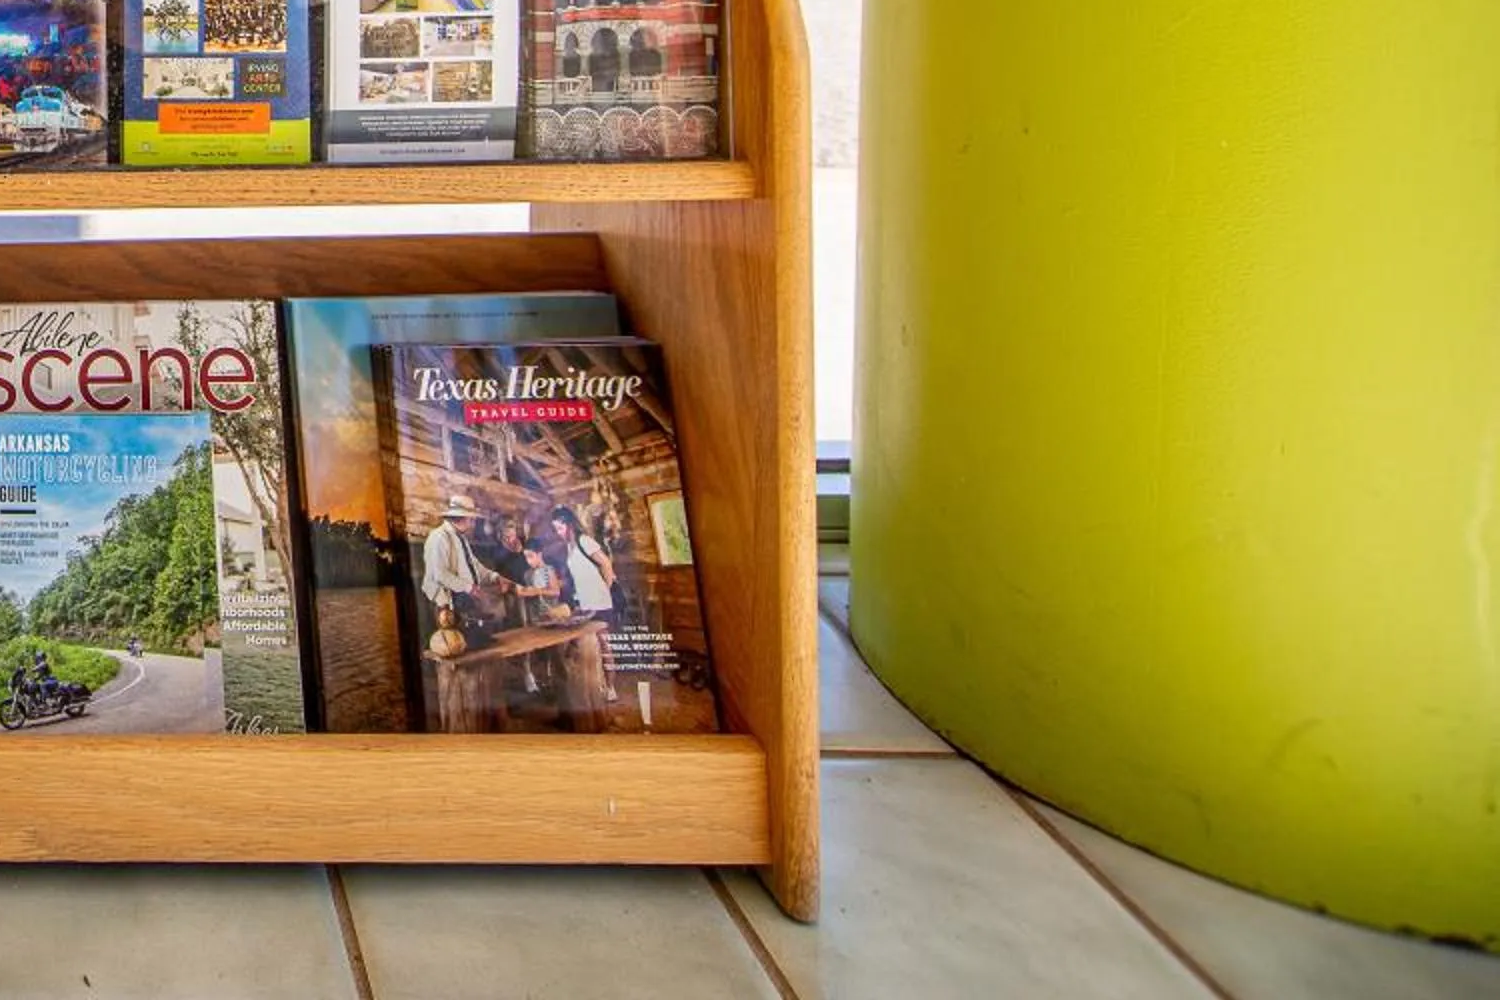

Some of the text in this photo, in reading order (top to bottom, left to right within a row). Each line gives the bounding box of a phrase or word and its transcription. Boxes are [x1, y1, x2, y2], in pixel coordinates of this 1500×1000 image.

[0, 310, 103, 357] Abilene
[412, 365, 643, 411] Texas Heritage
[471, 407, 588, 419] TRAVEL GUIDE
[0, 434, 71, 453] ARKANSAS
[0, 455, 158, 483] MOTORCYCLING
[0, 485, 37, 502] GUIDE
[223, 620, 287, 633] Affordable
